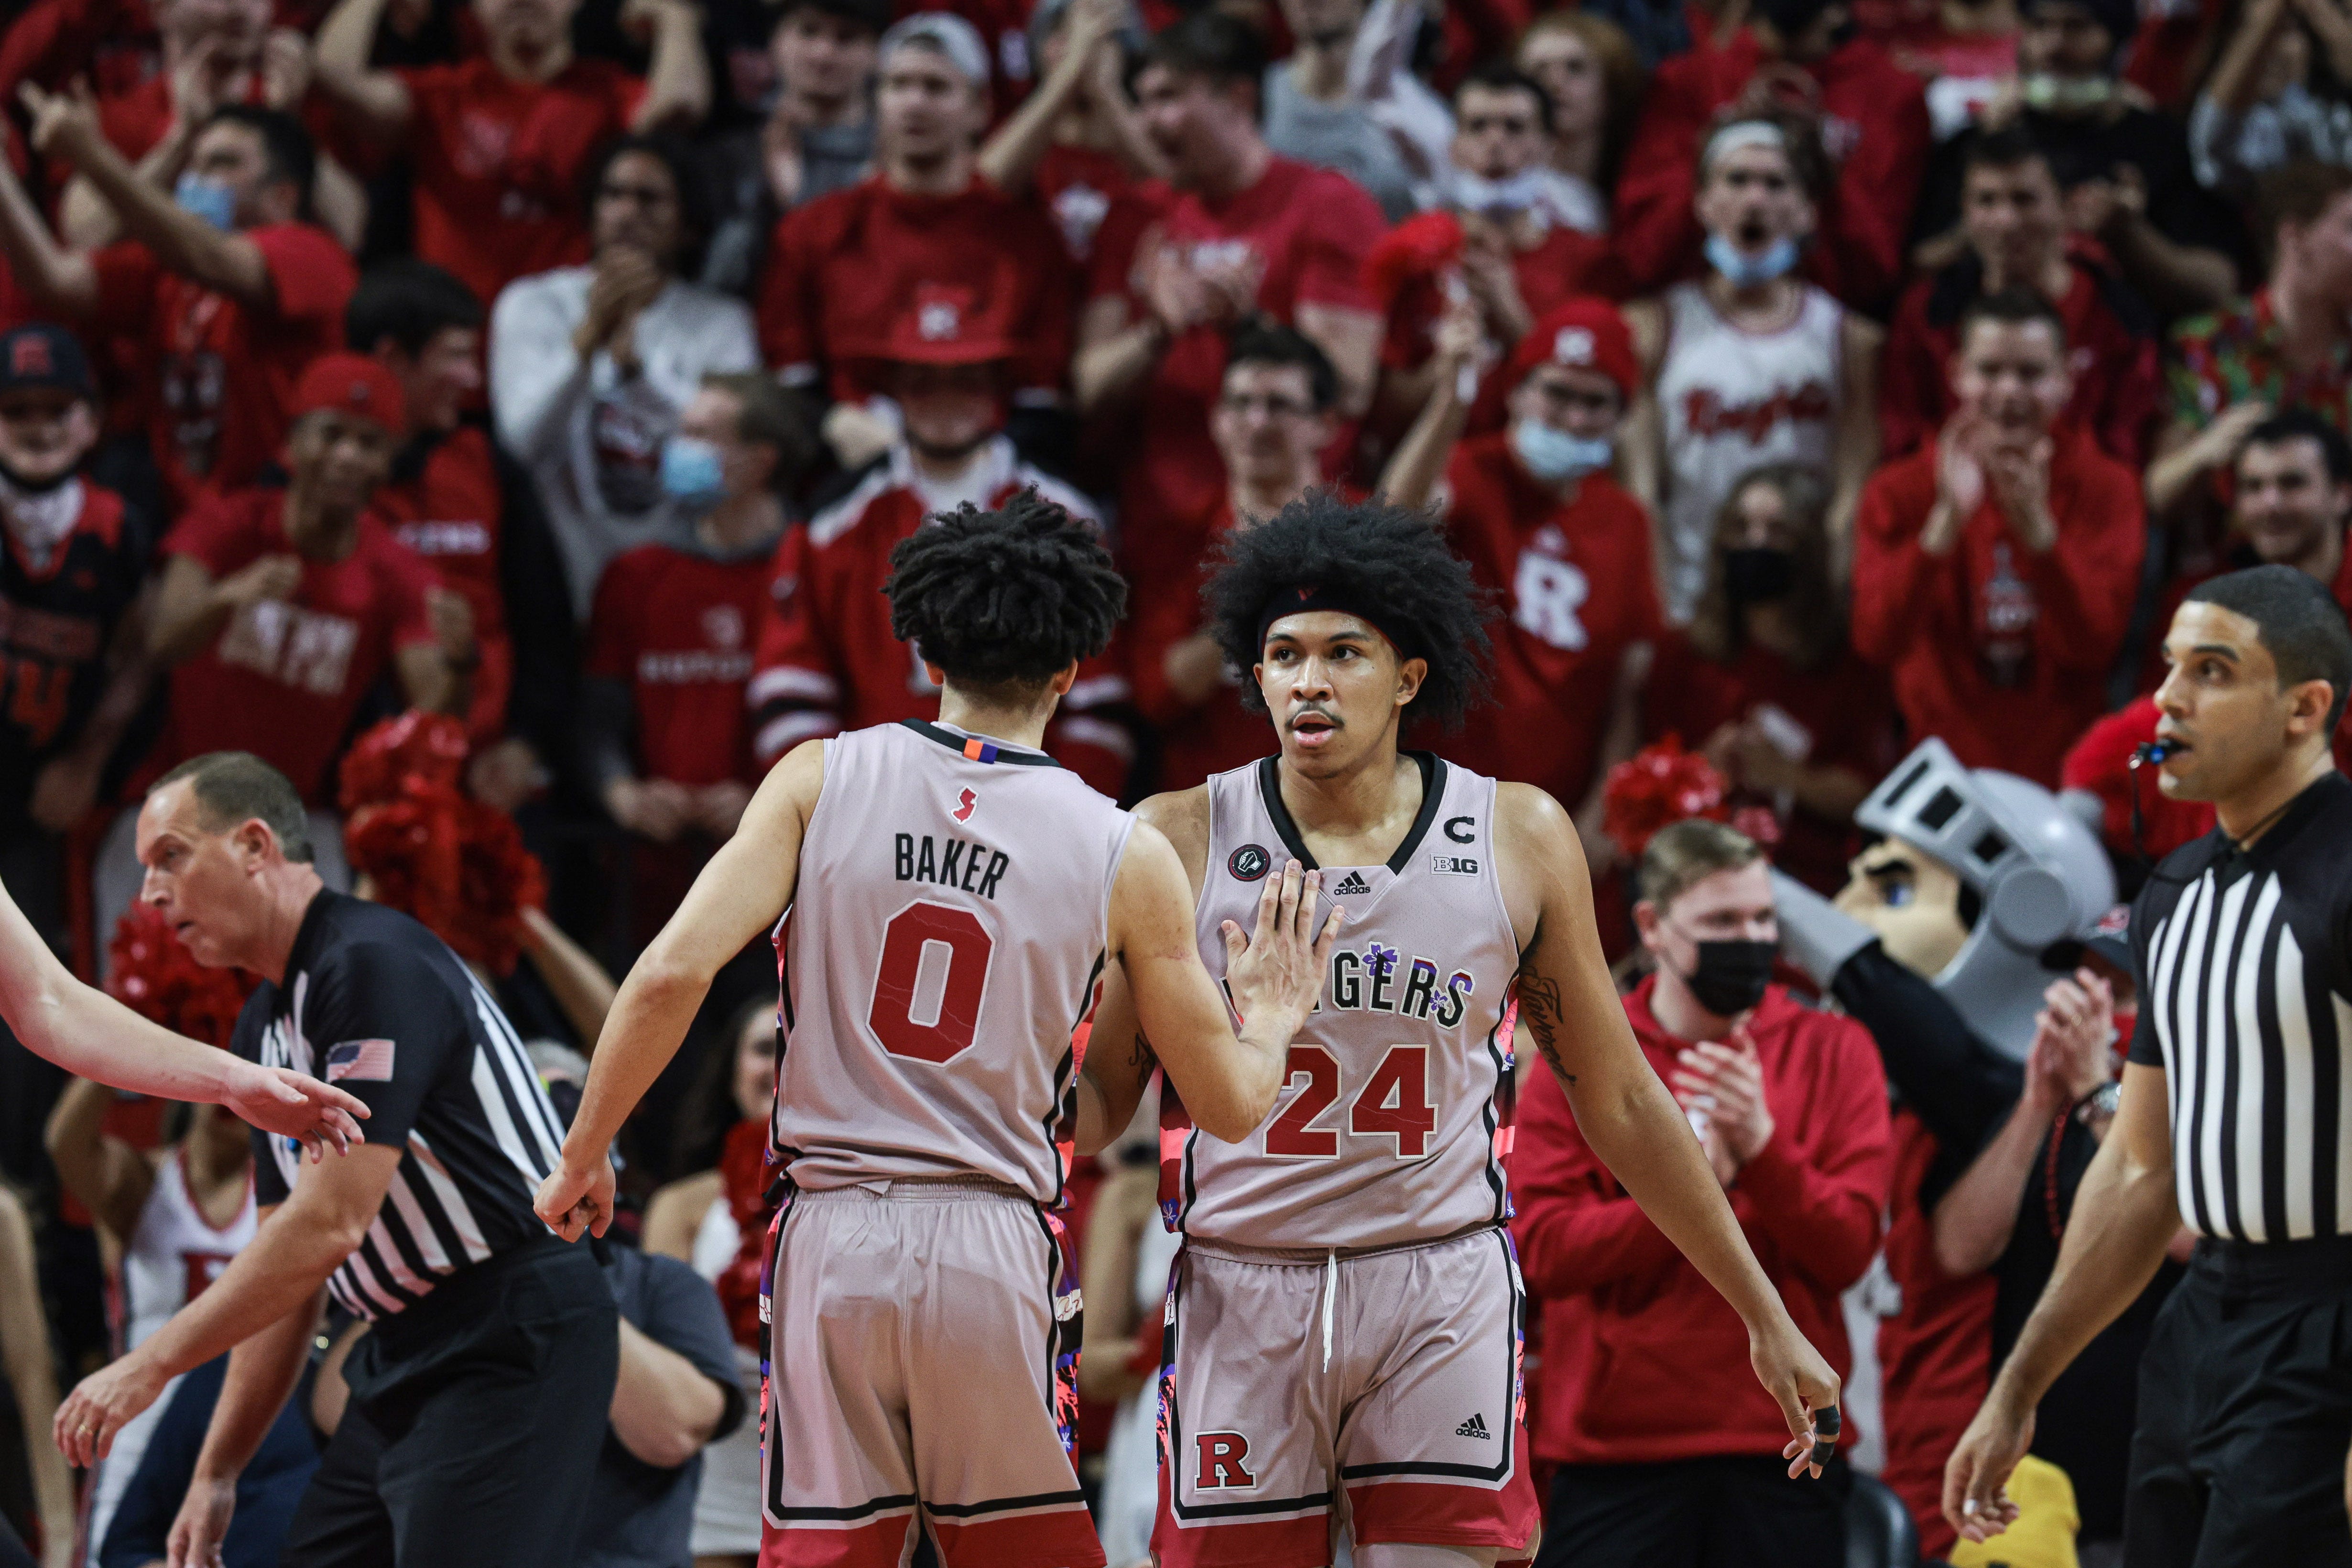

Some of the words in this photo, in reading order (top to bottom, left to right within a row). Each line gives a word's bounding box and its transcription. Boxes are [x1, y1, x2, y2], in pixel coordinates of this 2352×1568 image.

[1512, 546, 1590, 652] R
[1444, 816, 1475, 844] C
[895, 833, 1010, 900] BAKER
[1333, 885, 1371, 896] adidas
[865, 897, 996, 1068] 0
[1262, 1044, 1439, 1160] 24
[1194, 1430, 1257, 1492] R
[1455, 1426, 1491, 1440] adidas
